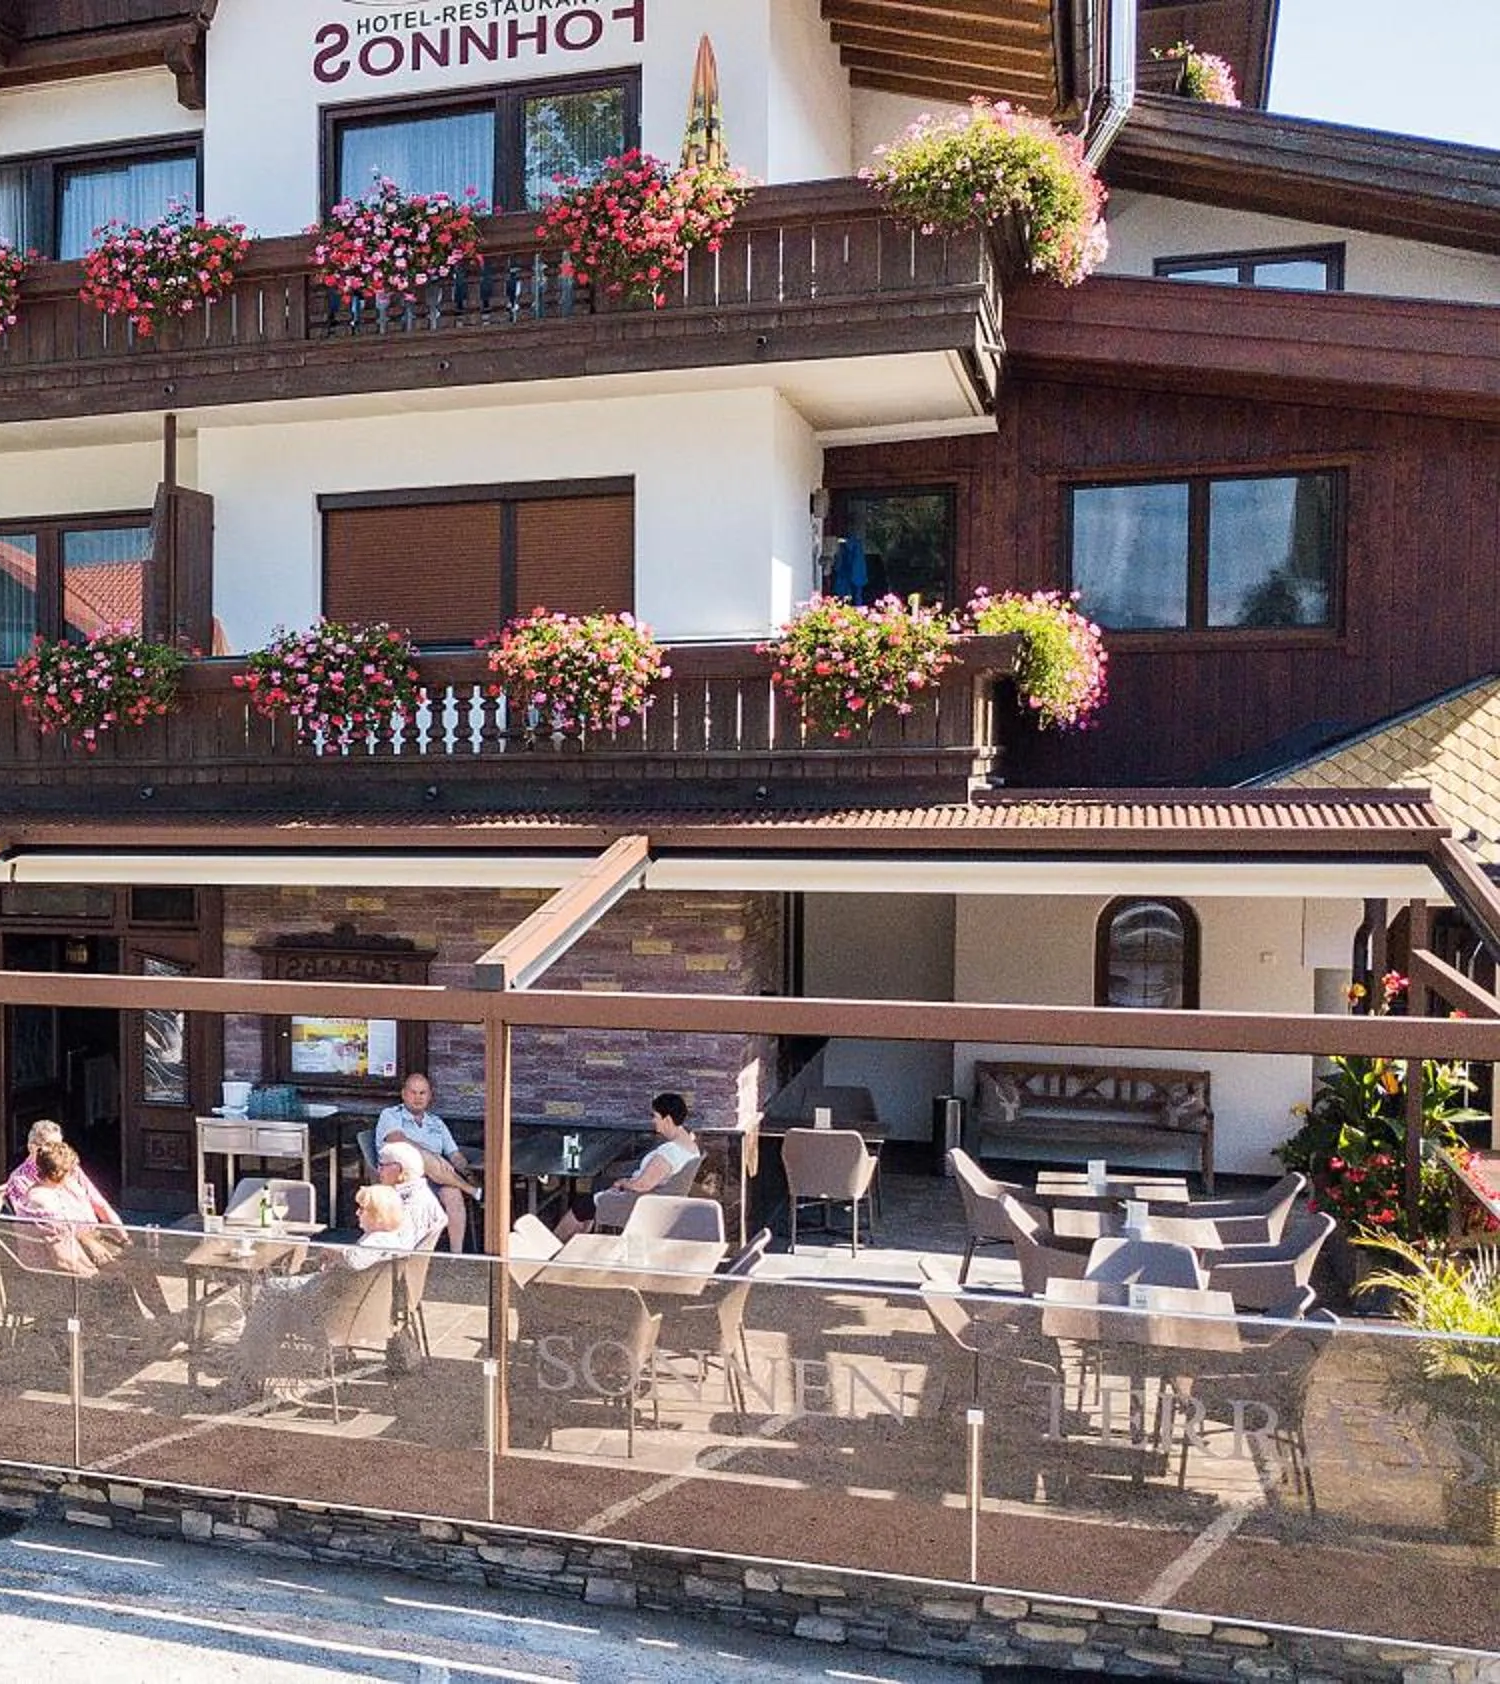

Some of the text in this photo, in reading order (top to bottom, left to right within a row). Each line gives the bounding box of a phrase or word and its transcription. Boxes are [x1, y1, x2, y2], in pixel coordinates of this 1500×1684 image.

[313, 0, 645, 83] SONNHOF
[357, 0, 604, 35] HOTEL-RESTAURA
[536, 1335, 912, 1426] SONNEN
